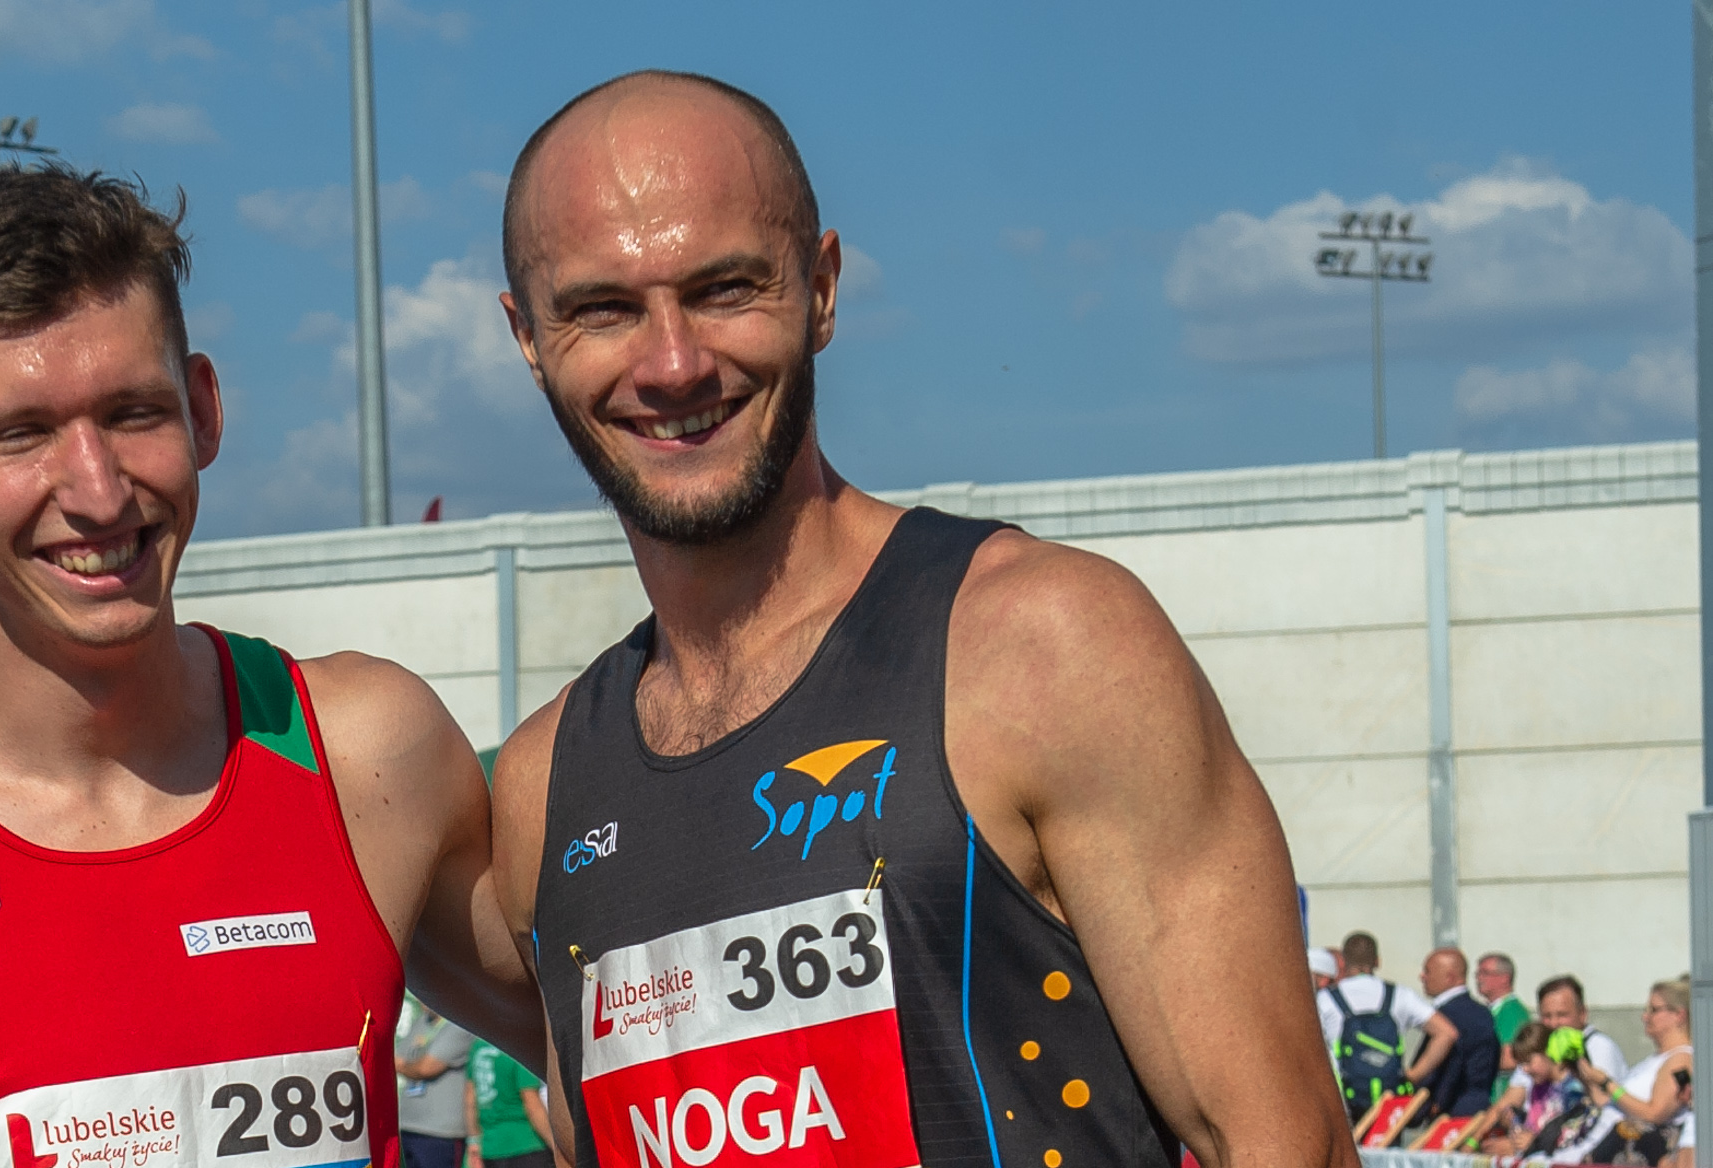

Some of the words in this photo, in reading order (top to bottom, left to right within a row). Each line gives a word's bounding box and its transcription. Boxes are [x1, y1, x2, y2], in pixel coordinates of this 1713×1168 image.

[751, 747, 896, 860] Sopot
[214, 916, 313, 946] Betacom
[723, 913, 884, 1012] 363
[619, 1003, 664, 1036] Smakuj
[210, 1070, 366, 1158] 289
[132, 1134, 181, 1167] życie!
